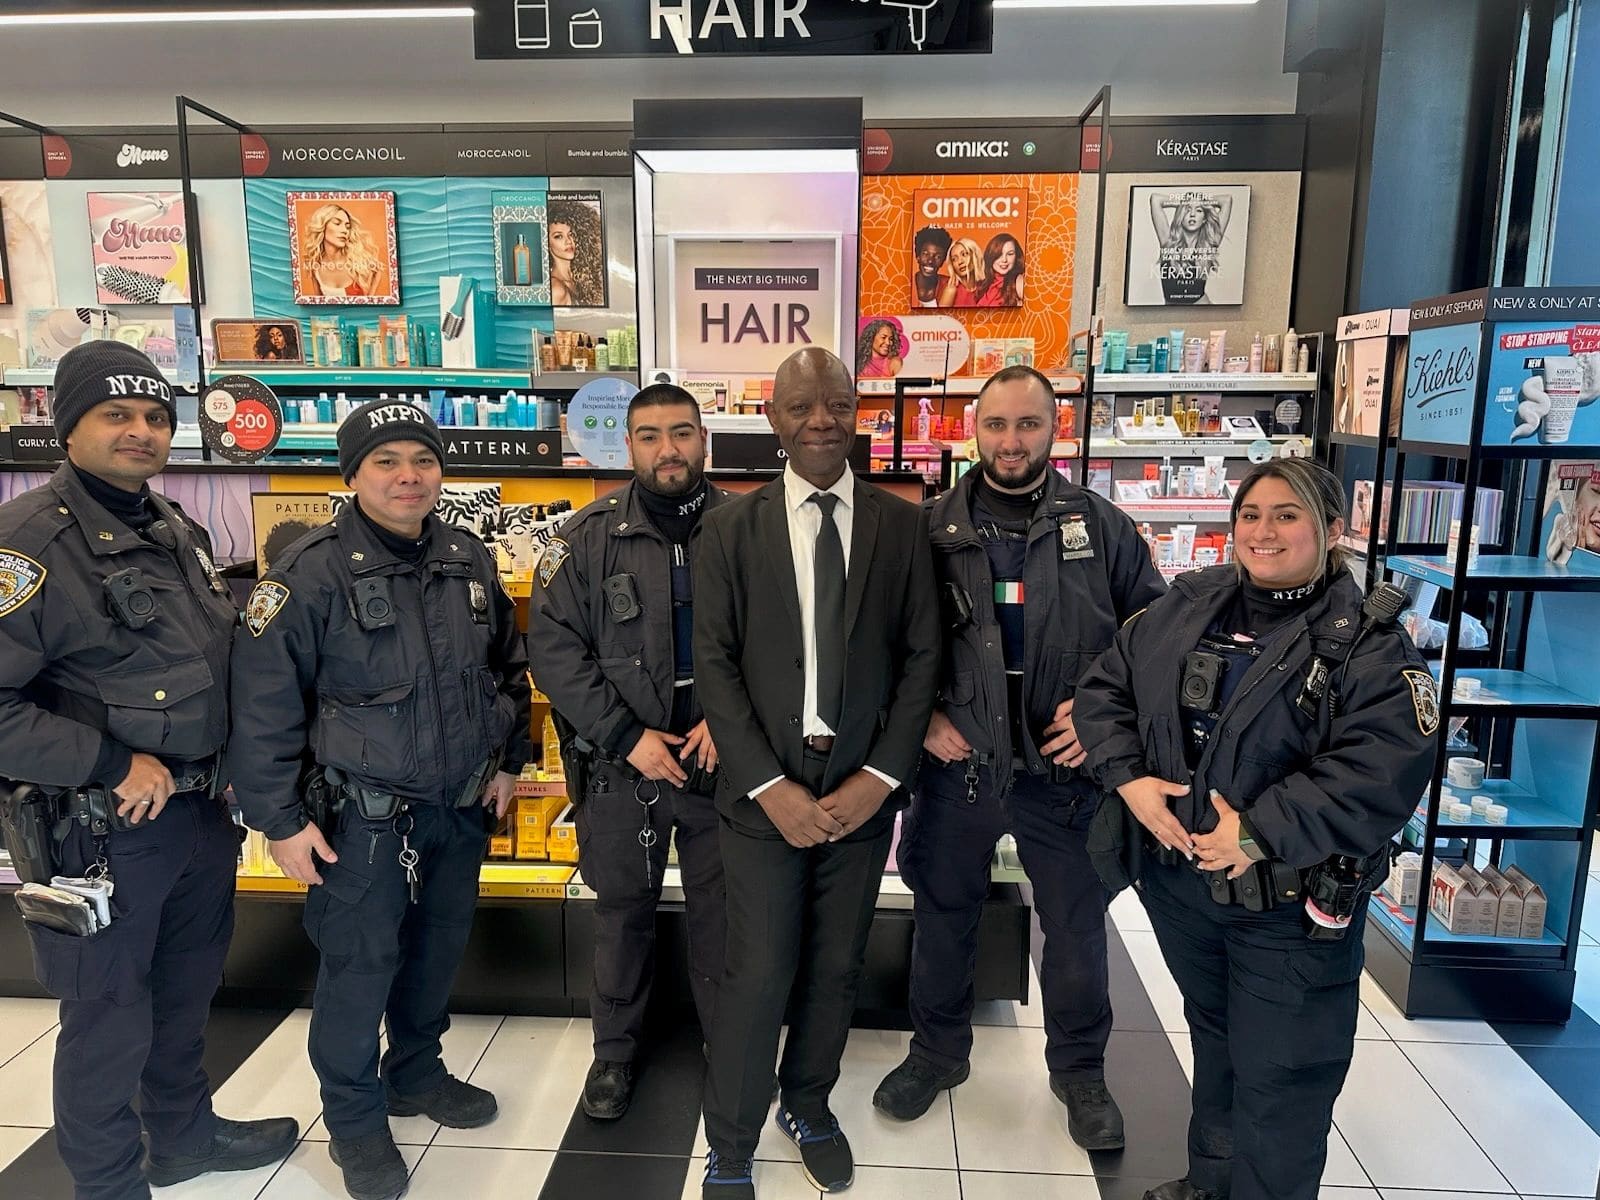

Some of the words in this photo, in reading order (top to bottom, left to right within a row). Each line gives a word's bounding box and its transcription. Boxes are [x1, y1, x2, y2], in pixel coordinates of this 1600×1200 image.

[651, 0, 811, 38] HAIR
[936, 140, 1009, 158] amika:
[1157, 138, 1228, 156] KÉRASTASE
[117, 143, 169, 168] Mane
[922, 196, 1020, 218] amika:
[102, 217, 183, 253] Mane
[706, 275, 725, 285] THE
[727, 275, 752, 285] NEXT
[755, 275, 773, 285] BIG
[776, 275, 808, 285] THING
[1429, 305, 1446, 318] ONLY
[1445, 303, 1454, 315] AT
[1453, 299, 1483, 314] SEPHORA
[1493, 298, 1525, 309] NEW
[1527, 298, 1537, 309] &
[1540, 297, 1576, 309] ONLY
[1577, 297, 1596, 308] AT
[701, 303, 812, 344] HAIR
[911, 330, 962, 342] amika:
[1506, 333, 1527, 348] STOP
[1527, 330, 1569, 347] STRIPPING
[1527, 359, 1542, 368] NEW
[1407, 346, 1474, 399] Kiehl's
[105, 374, 171, 402] NYPD
[682, 380, 725, 388] Ceremonia
[212, 401, 228, 410] $75
[582, 402, 616, 410] Responsible
[588, 394, 615, 402] Inspiring
[235, 413, 268, 429] 500
[367, 403, 425, 429] NYPD
[1420, 411, 1442, 421] SINCE
[1445, 408, 1464, 417] 1851
[18, 438, 48, 448] CURLY,
[275, 503, 329, 513] PATTER
[1188, 512, 1195, 520] K
[351, 552, 364, 561] 28
[15, 583, 35, 601] YORK
[1272, 583, 1316, 601] NYPD
[1334, 618, 1349, 629] 28
